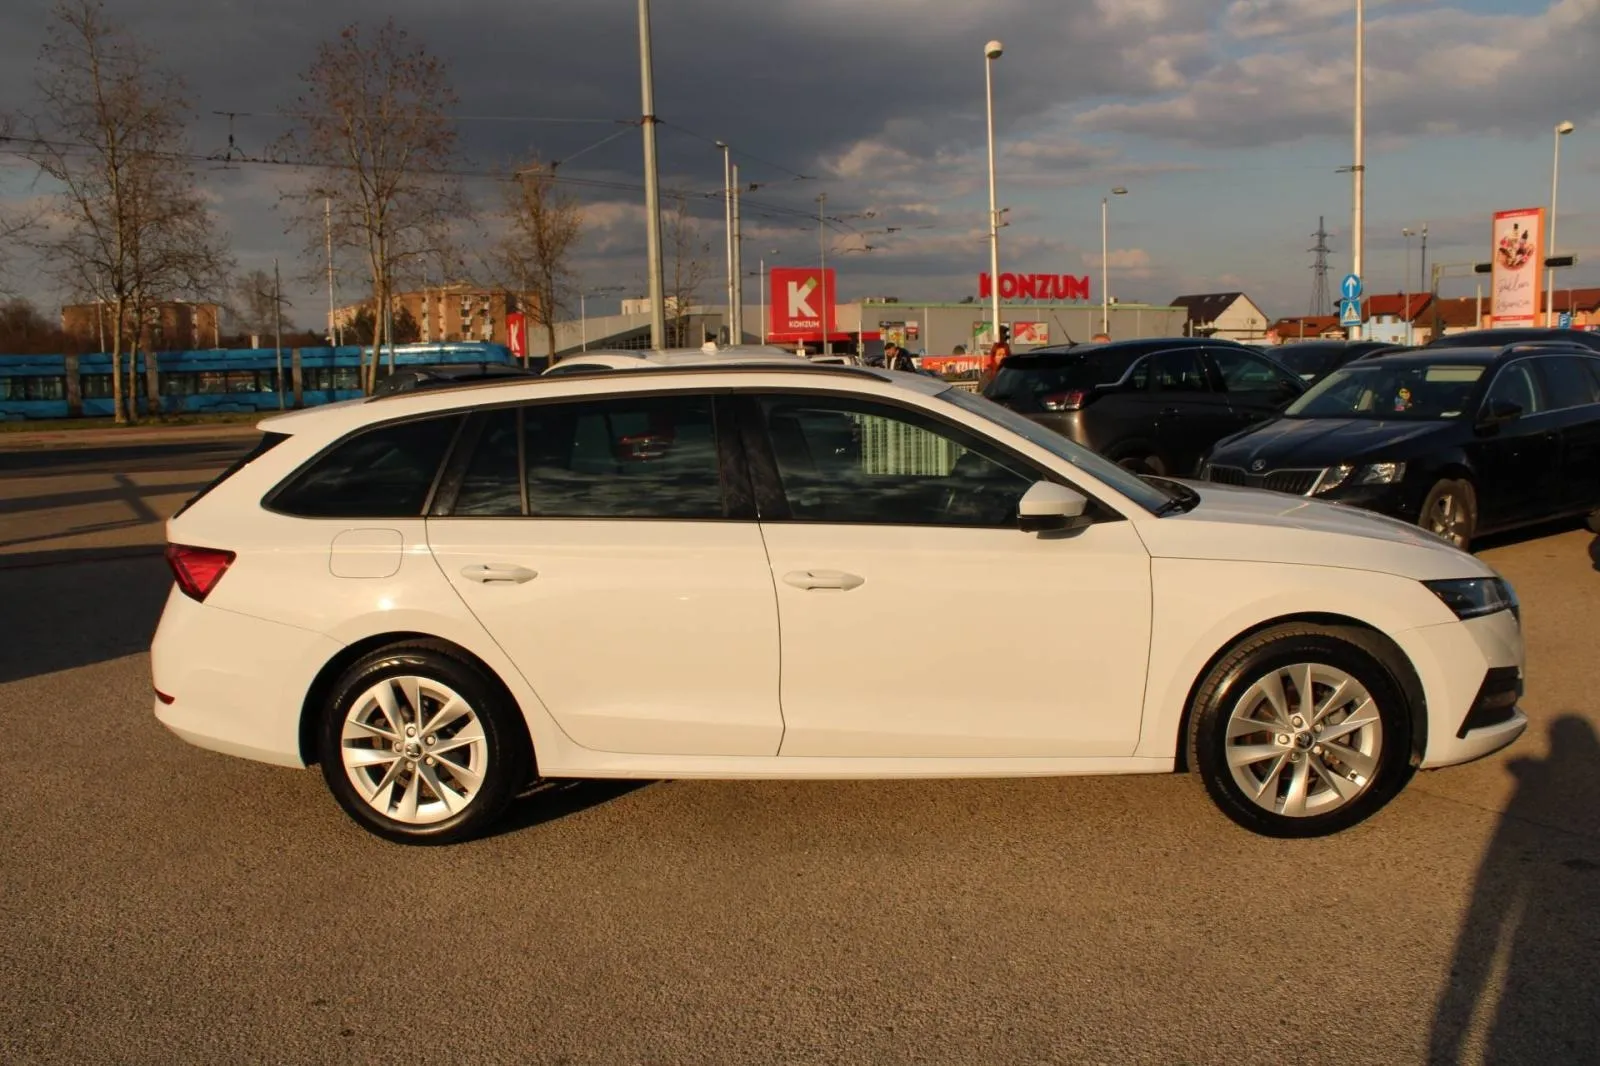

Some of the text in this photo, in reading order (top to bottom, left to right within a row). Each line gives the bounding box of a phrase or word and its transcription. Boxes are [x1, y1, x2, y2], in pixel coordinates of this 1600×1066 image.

[788, 277, 820, 318] K
[979, 272, 1090, 300] KONZUM
[788, 320, 820, 329] KONZUM
